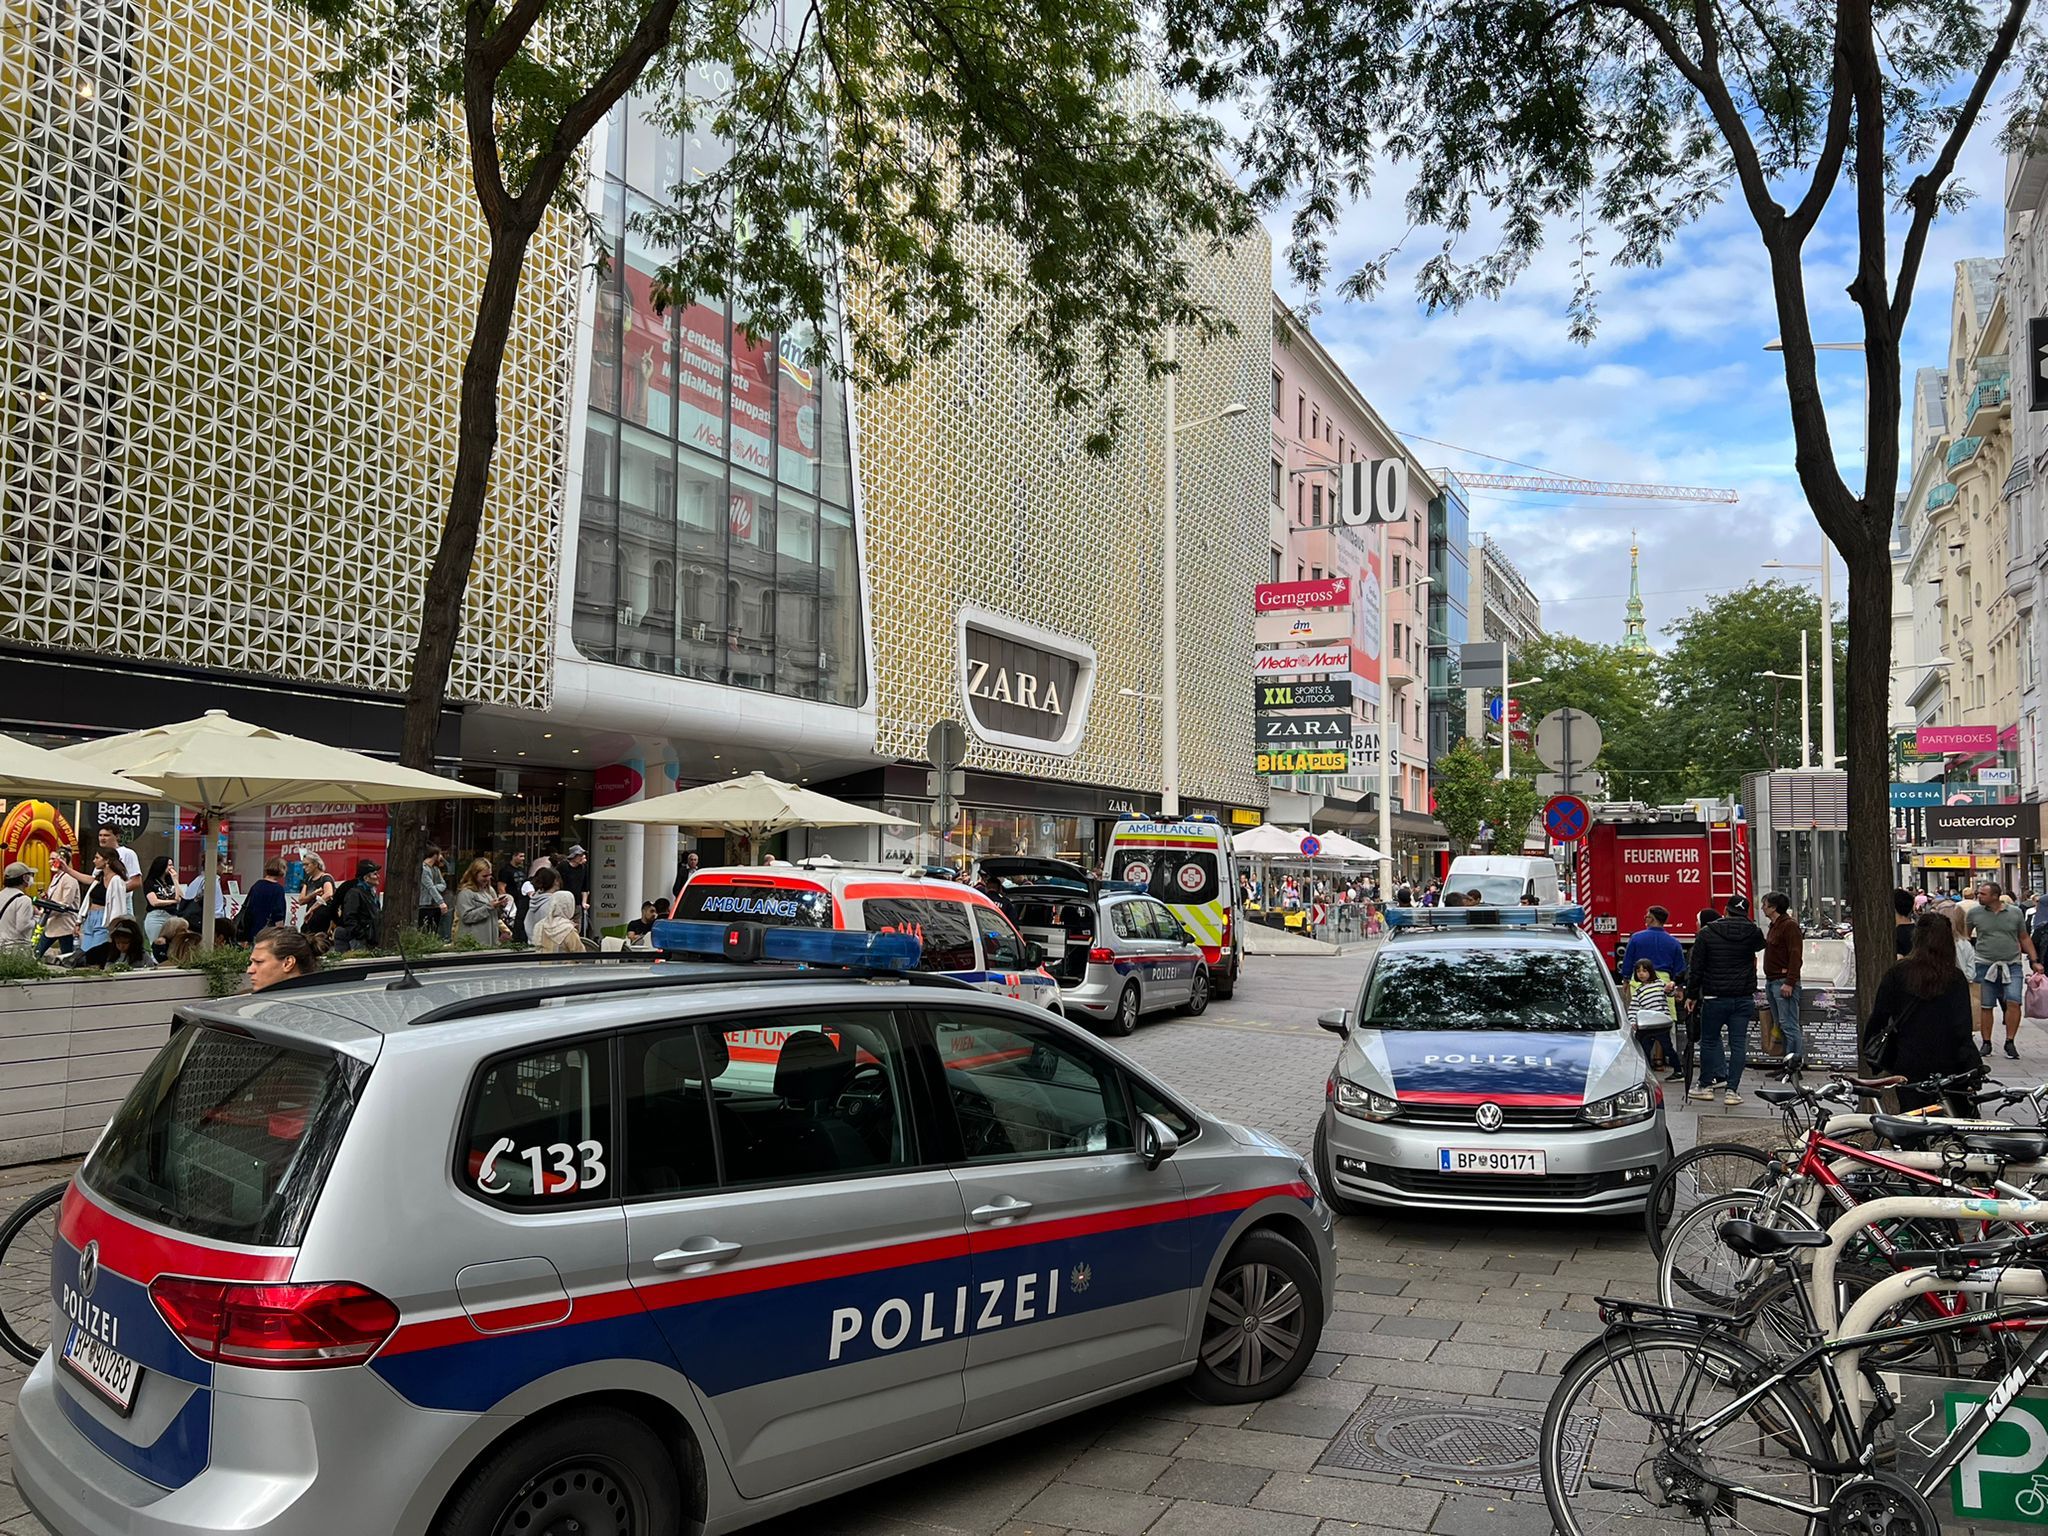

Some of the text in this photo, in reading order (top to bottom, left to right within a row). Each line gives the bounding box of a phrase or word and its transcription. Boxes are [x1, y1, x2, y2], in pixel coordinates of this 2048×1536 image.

[1342, 457, 1407, 525] UO
[1259, 589, 1333, 607] Gerngross
[1293, 619, 1310, 632] dm
[1254, 652, 1348, 671] Media Markt
[968, 659, 1063, 716] ZARA
[1263, 686, 1331, 705] XXL SPORTS &
[1294, 693, 1335, 705] OUTDOOR
[1266, 721, 1343, 736] ZARA
[1922, 733, 1993, 744] PARTYBOXES
[1257, 753, 1342, 771] BILLA PLUS
[98, 801, 141, 816] Back 2
[1108, 799, 1134, 813] ZARA
[97, 814, 140, 827] School
[1127, 822, 1205, 837] AMBULANCE
[9, 812, 31, 853] TROPICANA
[270, 822, 355, 842] im GERNGROSS
[280, 838, 346, 857] präsentiert:
[885, 849, 914, 861] ZARA
[1624, 849, 1699, 863] FEUERWEHR
[1625, 868, 1700, 883] NOTRUF 122
[701, 895, 798, 918] AMBULANCE
[1152, 967, 1177, 981] POLIZEI
[1424, 1053, 1553, 1067] POLIZEI
[521, 1139, 607, 1196] 133
[1457, 1153, 1478, 1169] BP
[1489, 1154, 1536, 1171] 90171
[62, 1283, 118, 1347] POLIZEI
[828, 1269, 1059, 1361] POLIZEI
[1969, 1312, 1998, 1323] AVENZA
[92, 1343, 132, 1394] 90268
[1984, 1365, 2027, 1423] KTM
[1955, 1402, 2048, 1509] P
